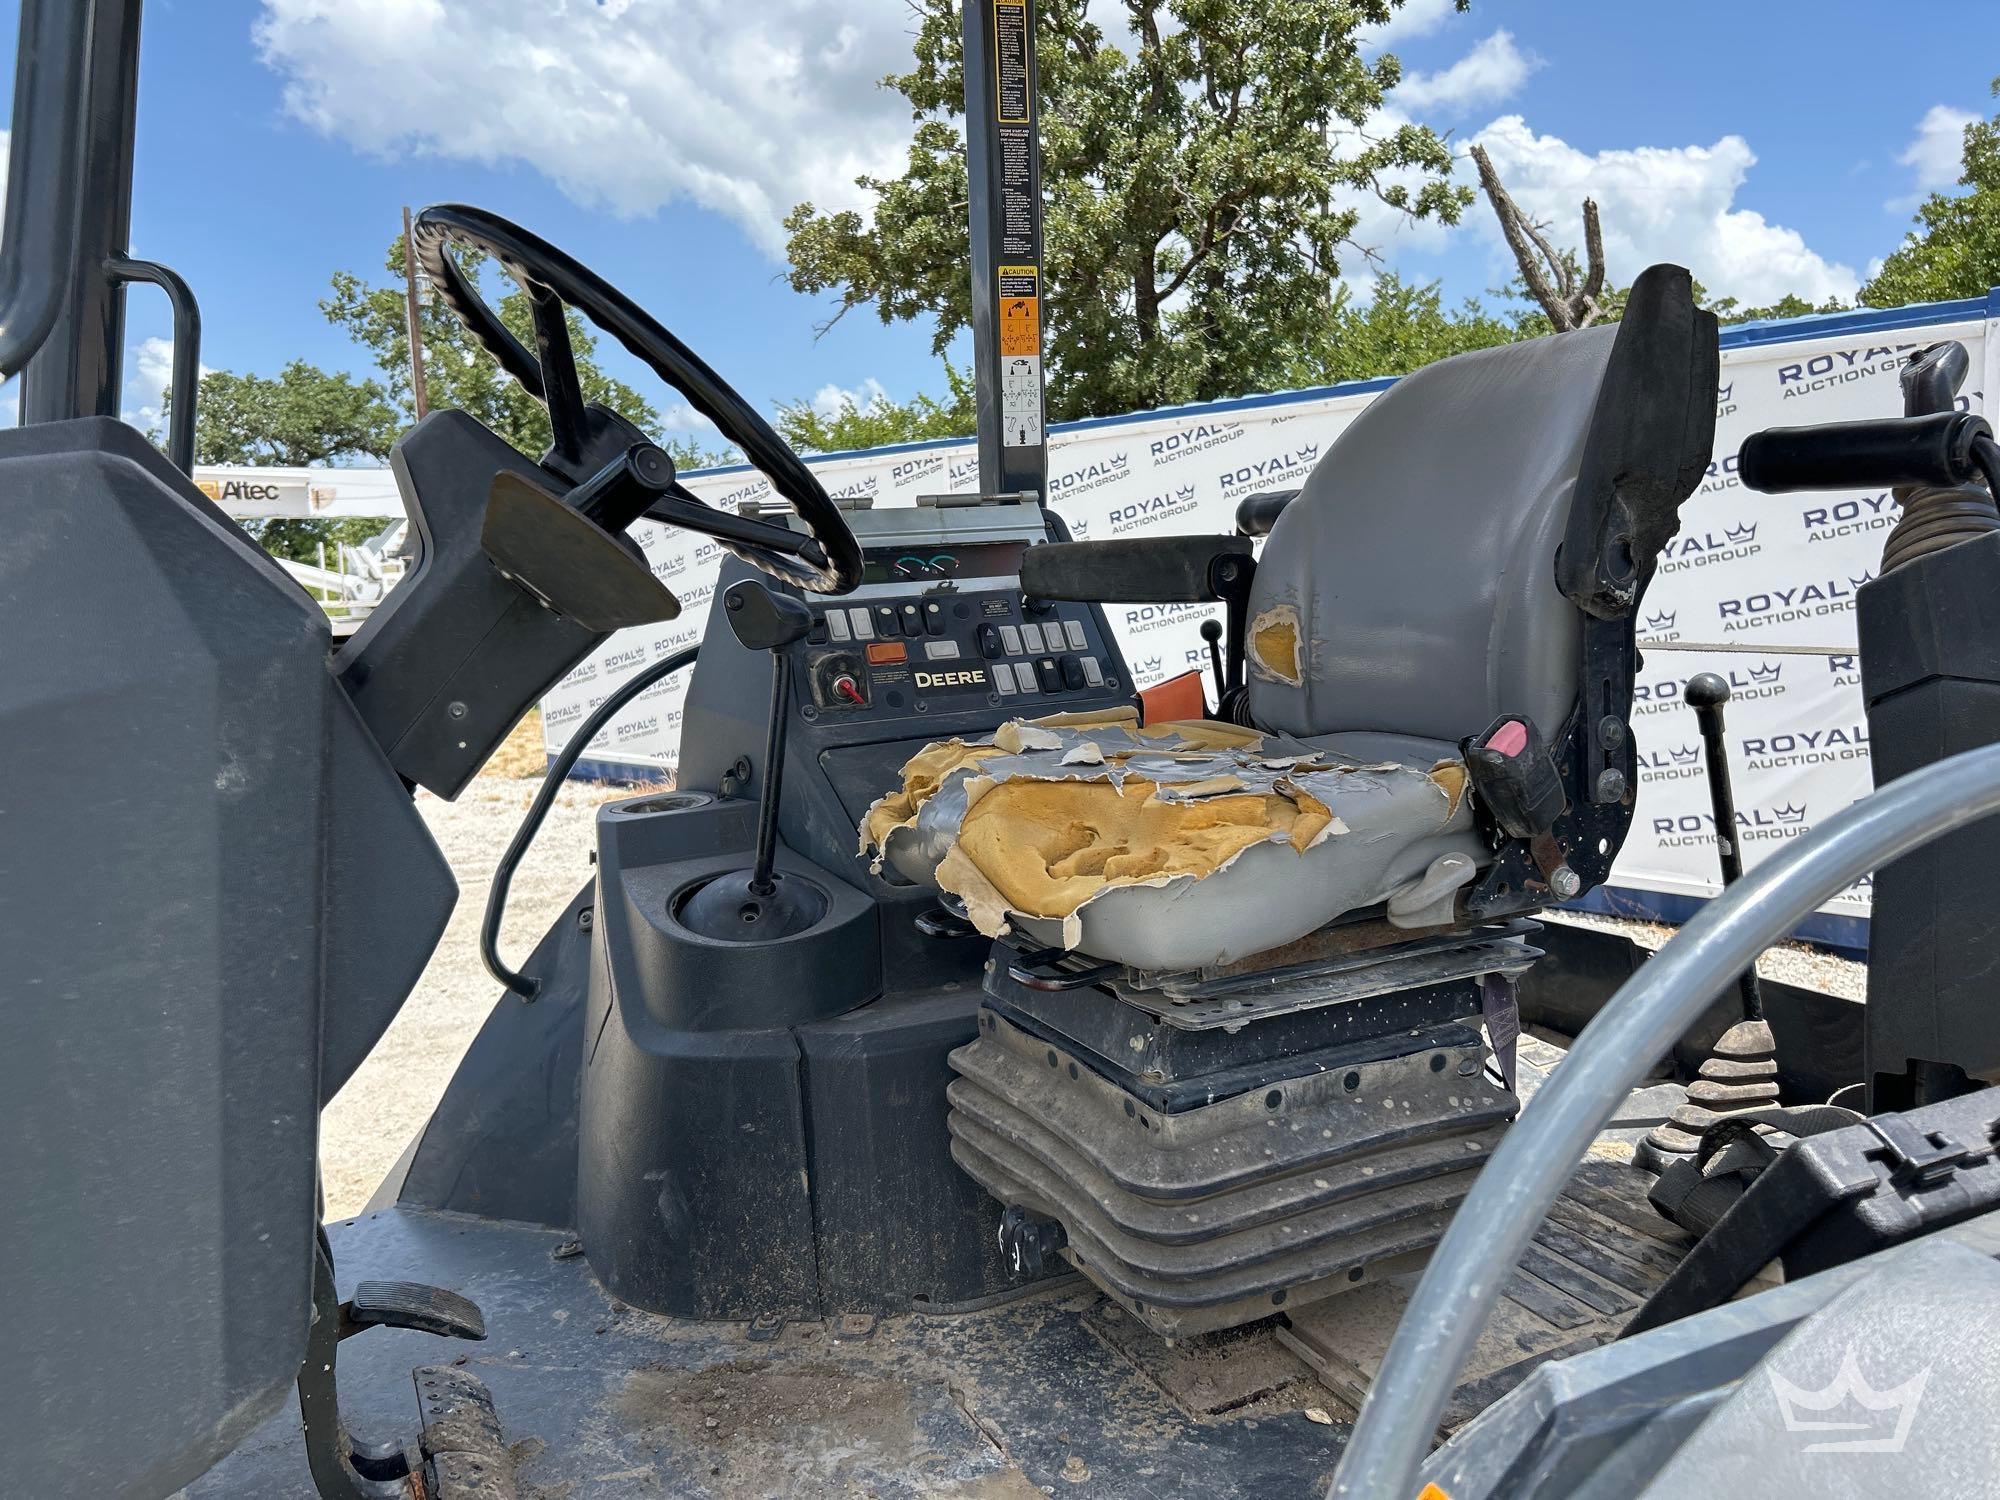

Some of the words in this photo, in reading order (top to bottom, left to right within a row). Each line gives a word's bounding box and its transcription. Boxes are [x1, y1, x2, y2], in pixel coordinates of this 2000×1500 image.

[1778, 344, 1917, 385] ROYA
[1783, 365, 1876, 399] AUCTION
[1150, 424, 1222, 457] ROYAL
[1154, 444, 1203, 467] AUCTION
[1204, 429, 1244, 449] GROUP
[892, 457, 943, 479] ROYA
[895, 471, 929, 488] AUCTION
[1049, 462, 1111, 493] ROYAL
[1220, 454, 1297, 488] ROYAL
[221, 481, 280, 500] Altec
[720, 485, 759, 508] ROYAL
[1051, 480, 1094, 502] AUCTION
[1095, 469, 1130, 487] GROUP
[1223, 477, 1276, 499] AUCTION
[1109, 494, 1177, 525] ROYAL
[1112, 514, 1158, 535] AUCTION
[1160, 501, 1198, 519] GROUP
[1803, 493, 1898, 528] ROY
[1808, 514, 1901, 543] AUCTION
[1663, 533, 1725, 558] YAL
[1694, 544, 1761, 567] GROUP
[1719, 581, 1849, 618] ROYAL
[1129, 616, 1175, 635] AUCTION
[1177, 607, 1216, 623] GROUP
[1723, 608, 1811, 632] AUCTION
[1816, 600, 1857, 616] GRO
[655, 633, 688, 651] ROYAL
[605, 650, 637, 668] ROYAL
[914, 670, 986, 688] DEERE
[1136, 673, 1164, 685] ROUP
[546, 707, 574, 720] ROYAL
[1635, 701, 1686, 716] AUCTI
[1731, 685, 1786, 702] ROUP
[617, 720, 649, 736] ROYAL
[1742, 726, 1870, 757] ROYAL
[1748, 752, 1835, 770] AUCTION
[1642, 767, 1704, 782] GROUP
[1742, 826, 1810, 841] GROUP
